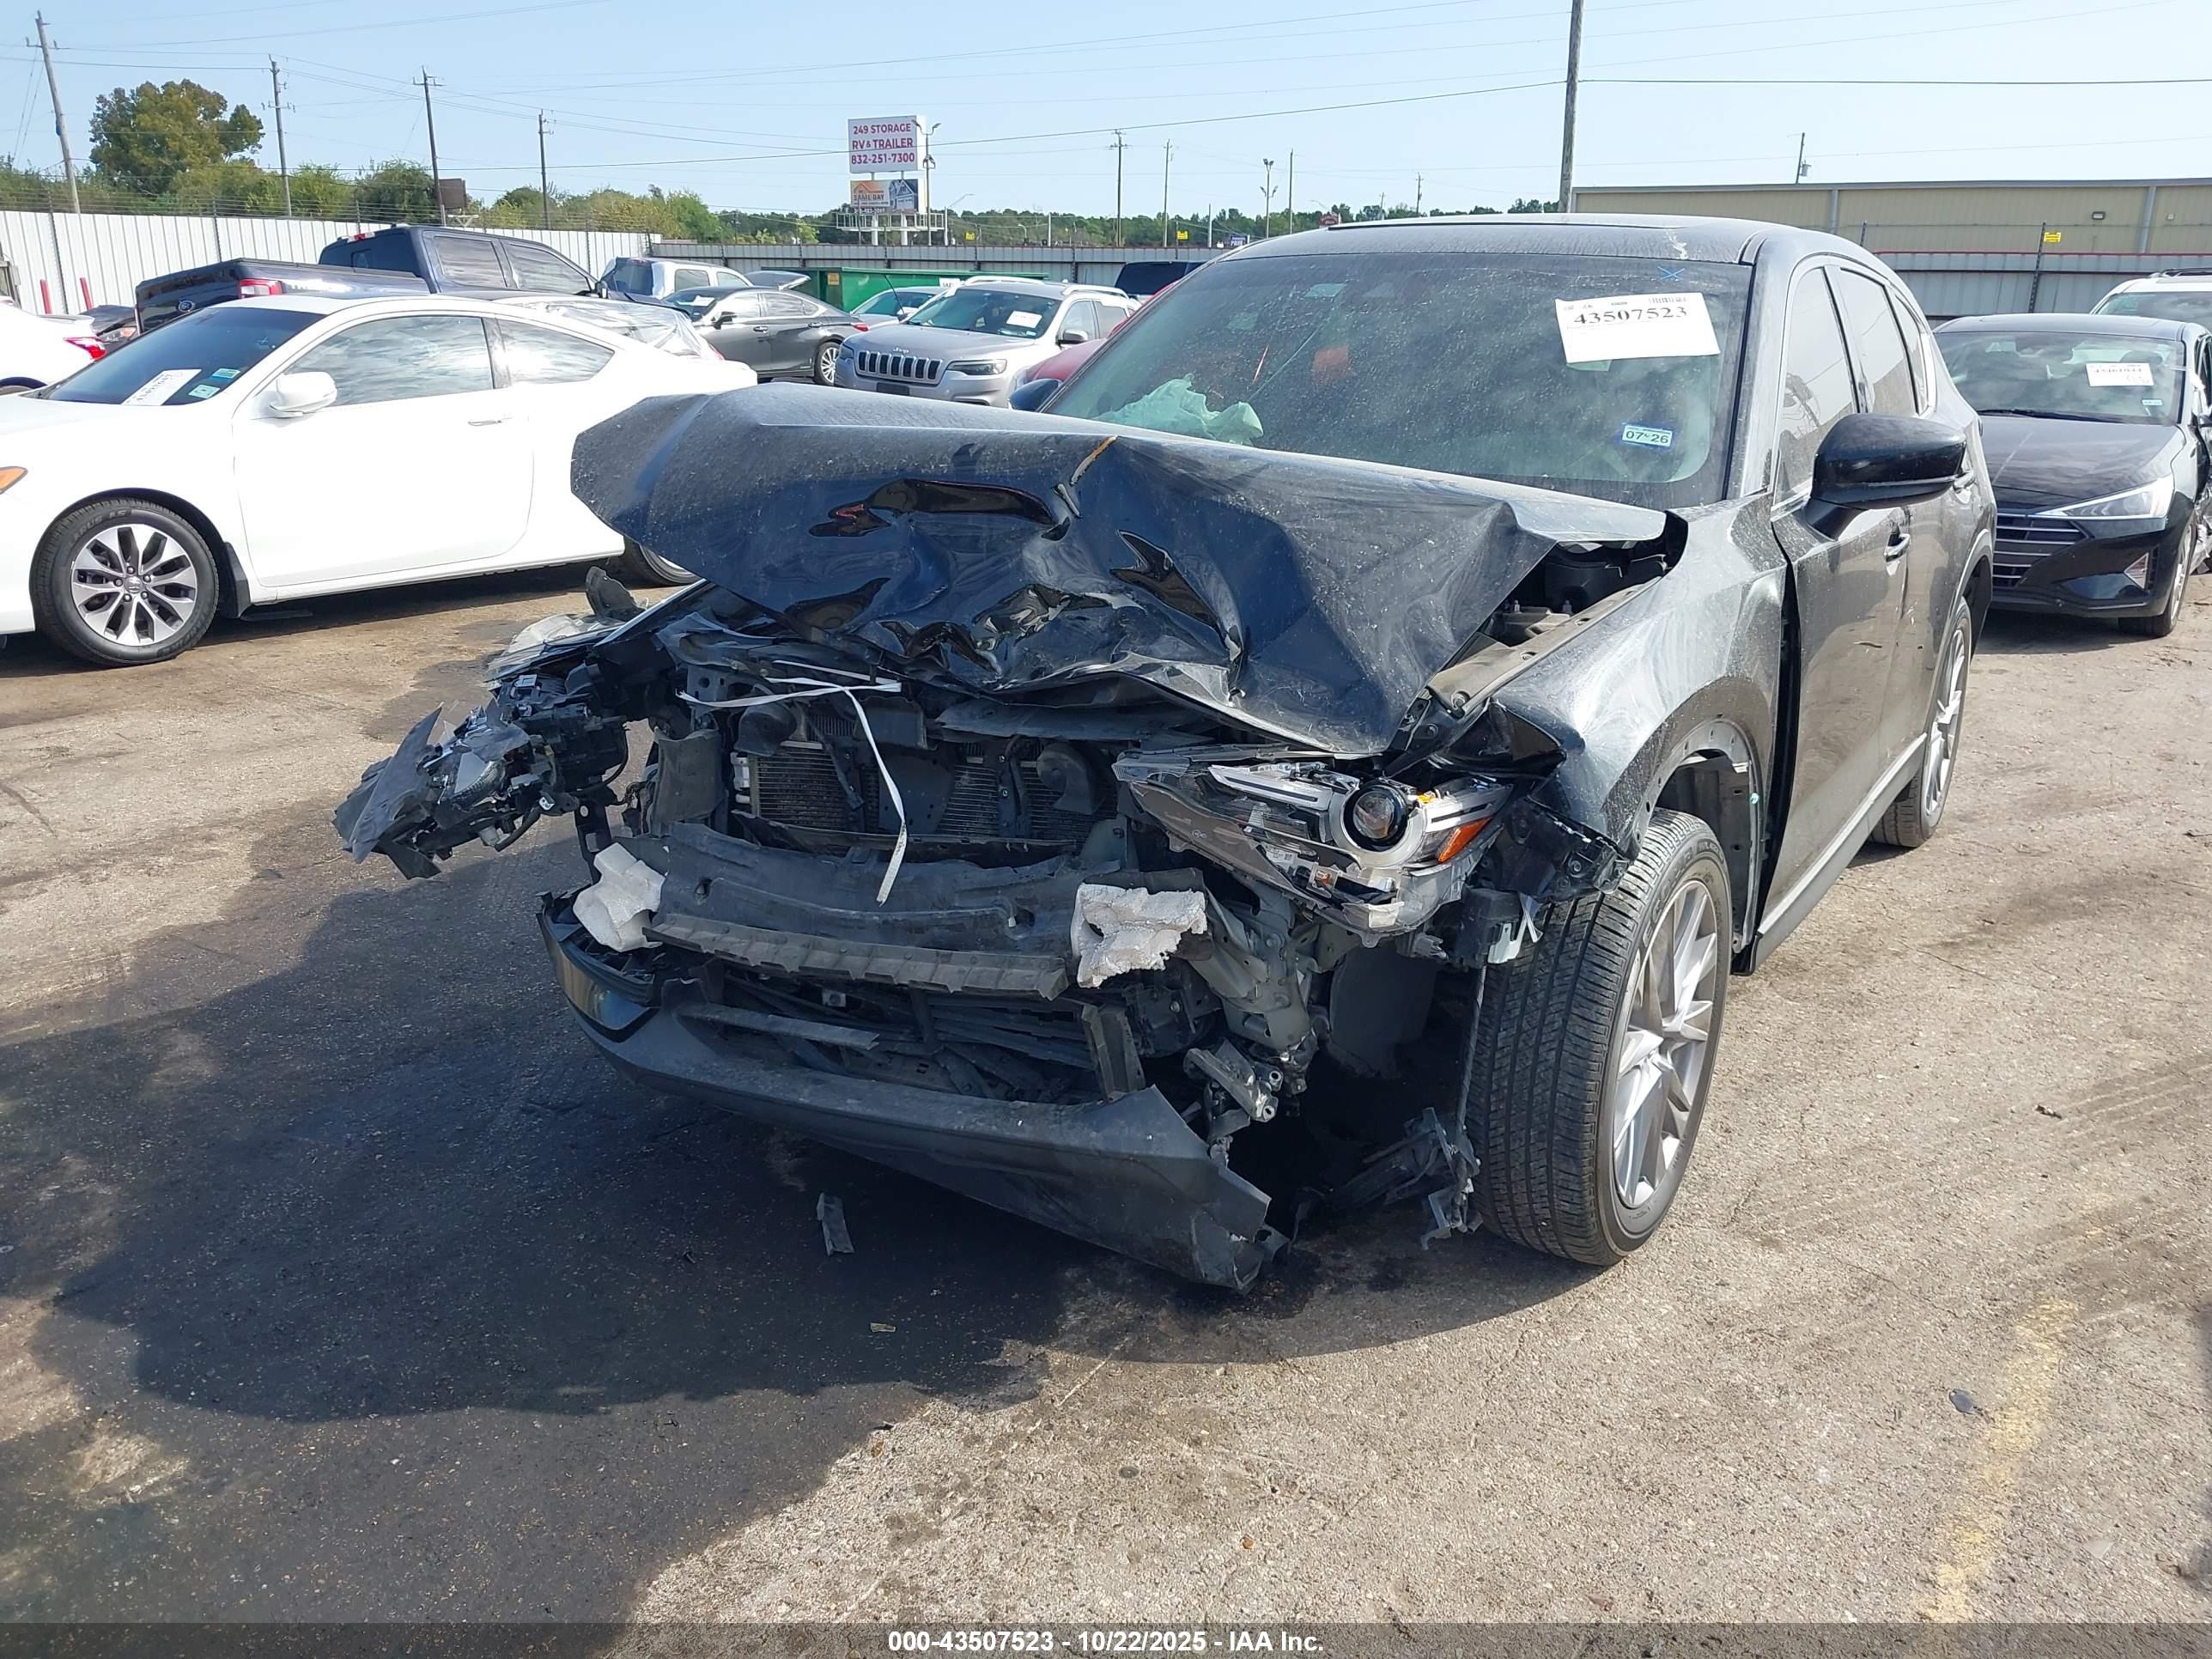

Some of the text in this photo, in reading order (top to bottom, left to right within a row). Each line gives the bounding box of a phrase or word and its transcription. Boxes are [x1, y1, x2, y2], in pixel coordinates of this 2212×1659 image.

[853, 124, 911, 135] 249 STORAGE
[852, 140, 866, 149] RV
[872, 137, 914, 149] TRAILER
[851, 153, 915, 164] 832-251-7300
[1573, 307, 1687, 325] 43507523
[1626, 430, 1644, 440] 07
[1650, 434, 1668, 444] 26
